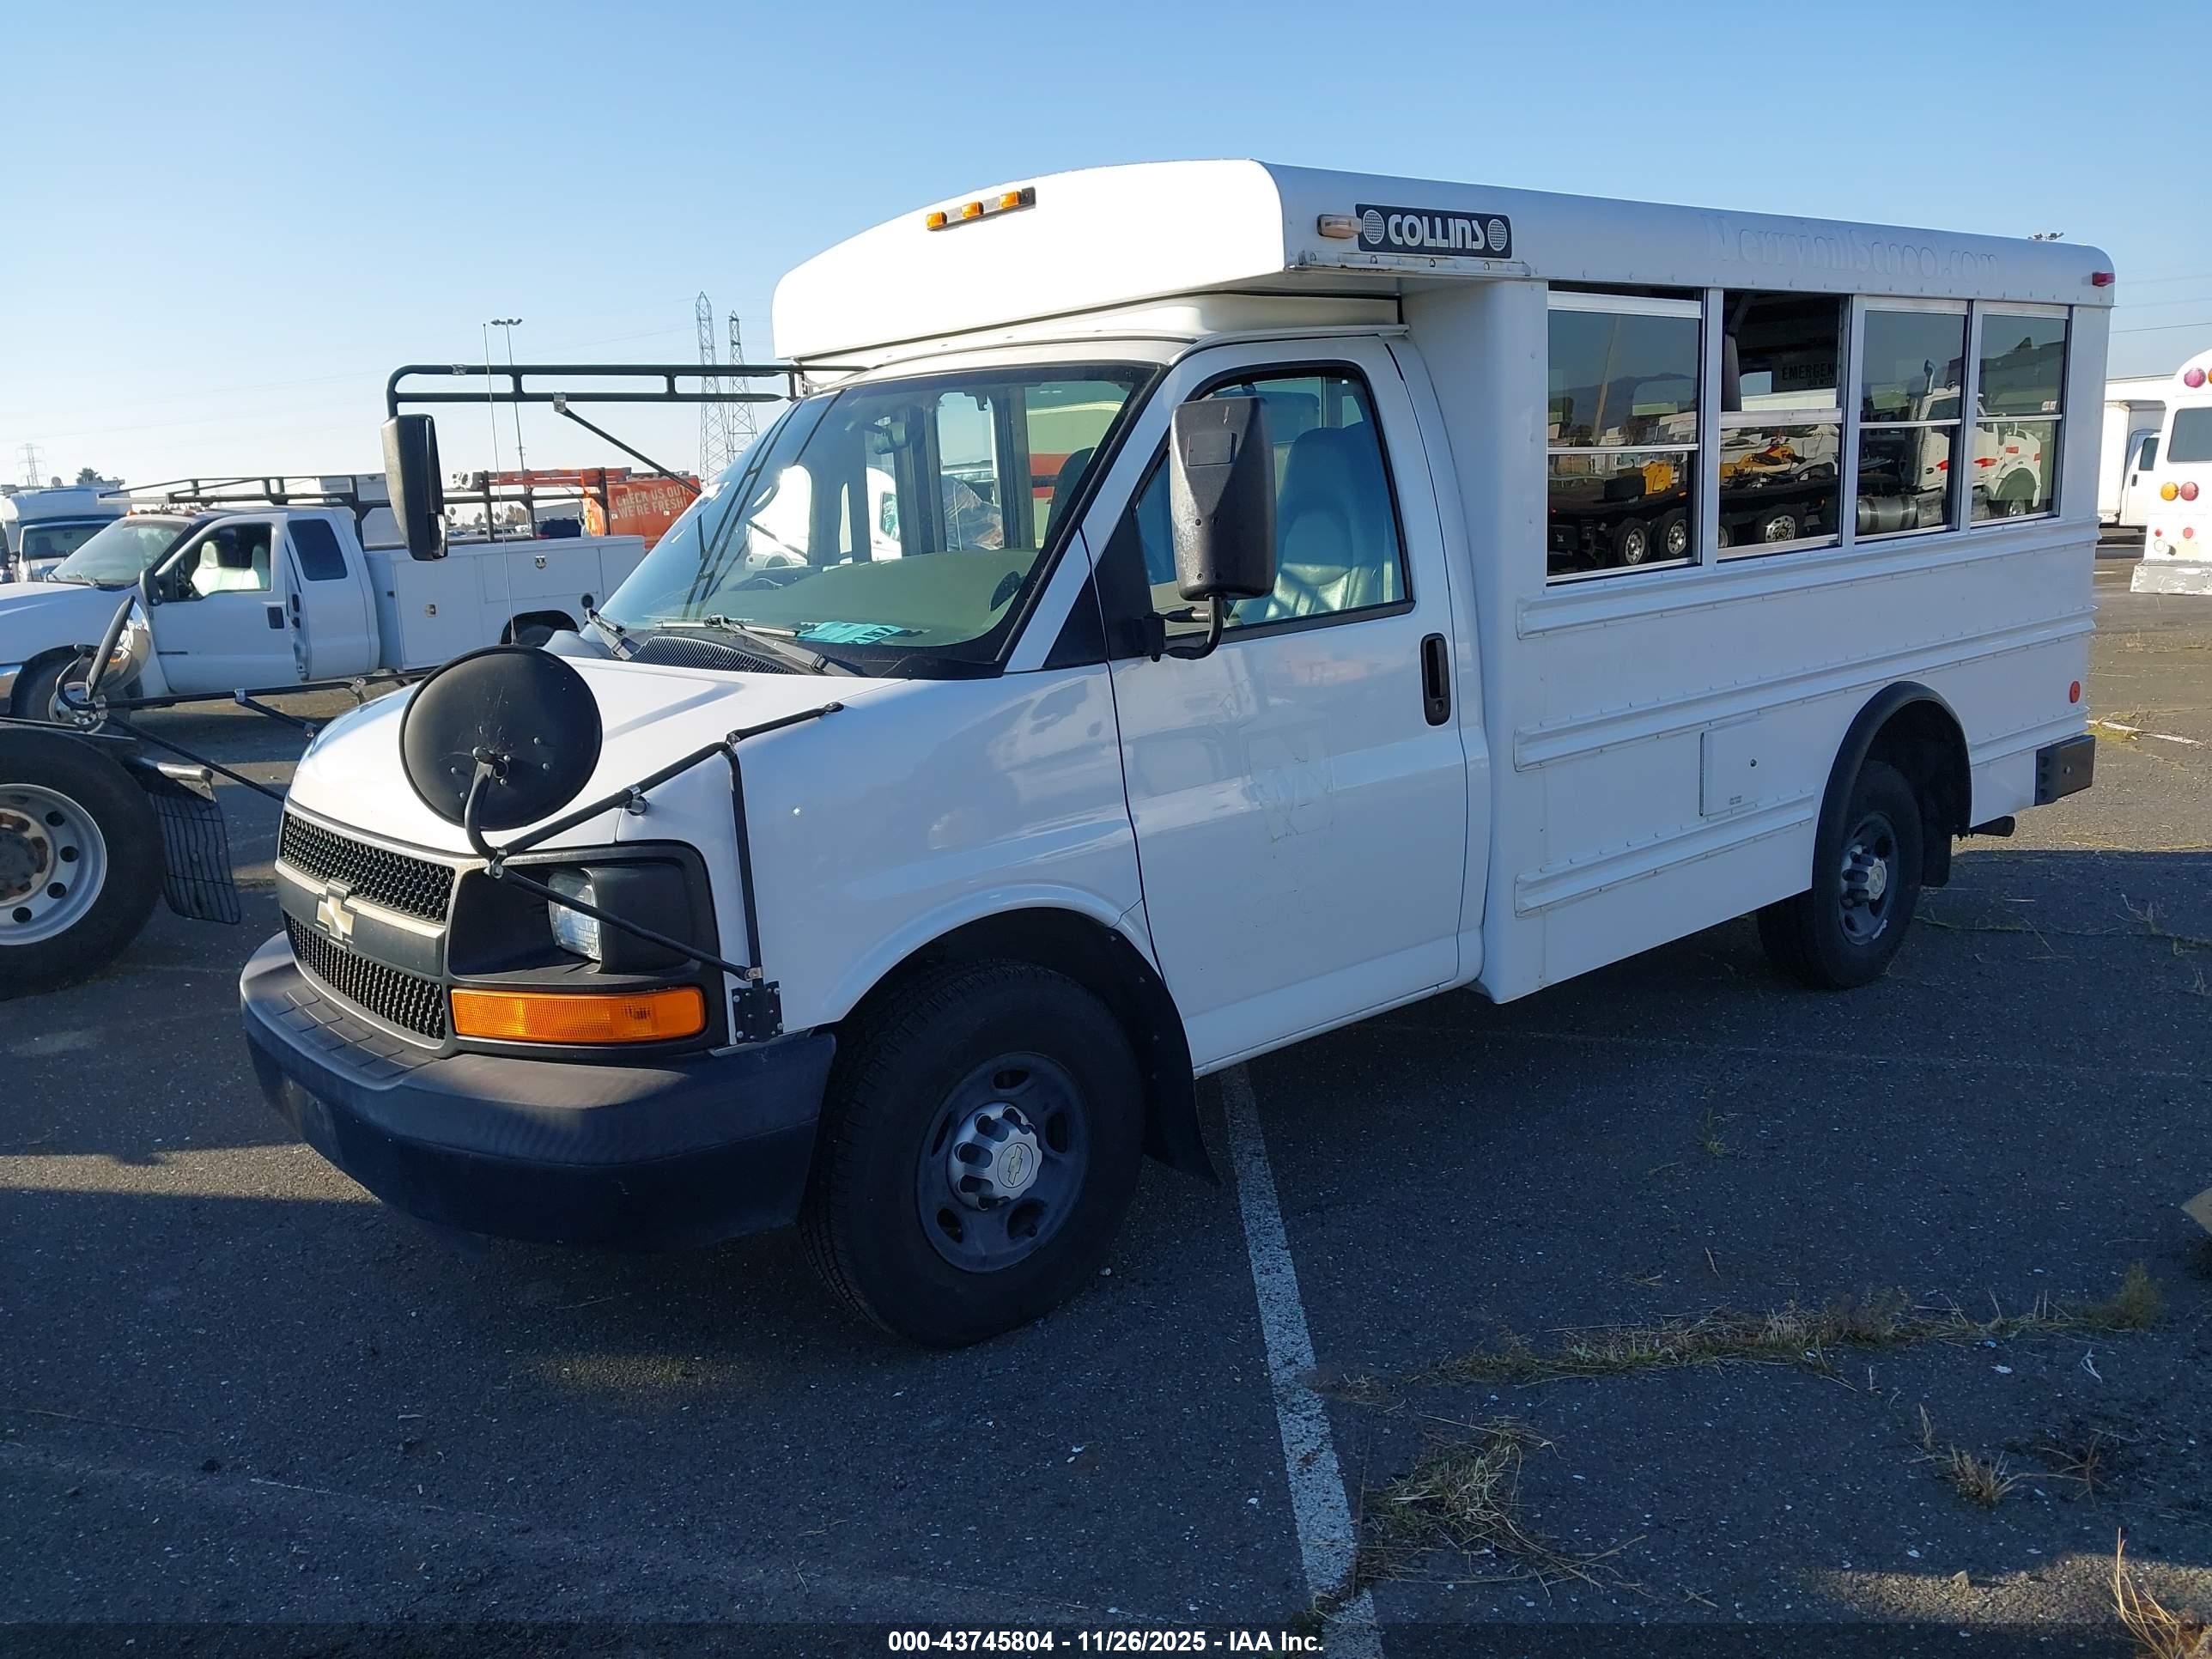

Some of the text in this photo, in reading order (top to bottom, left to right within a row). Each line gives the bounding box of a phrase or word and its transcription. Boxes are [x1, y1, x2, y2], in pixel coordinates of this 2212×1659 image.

[1388, 214, 1486, 250] COLLINS
[616, 490, 649, 507] CHECK
[650, 488, 665, 501] US
[617, 496, 688, 520] WE'RE FRESH!
